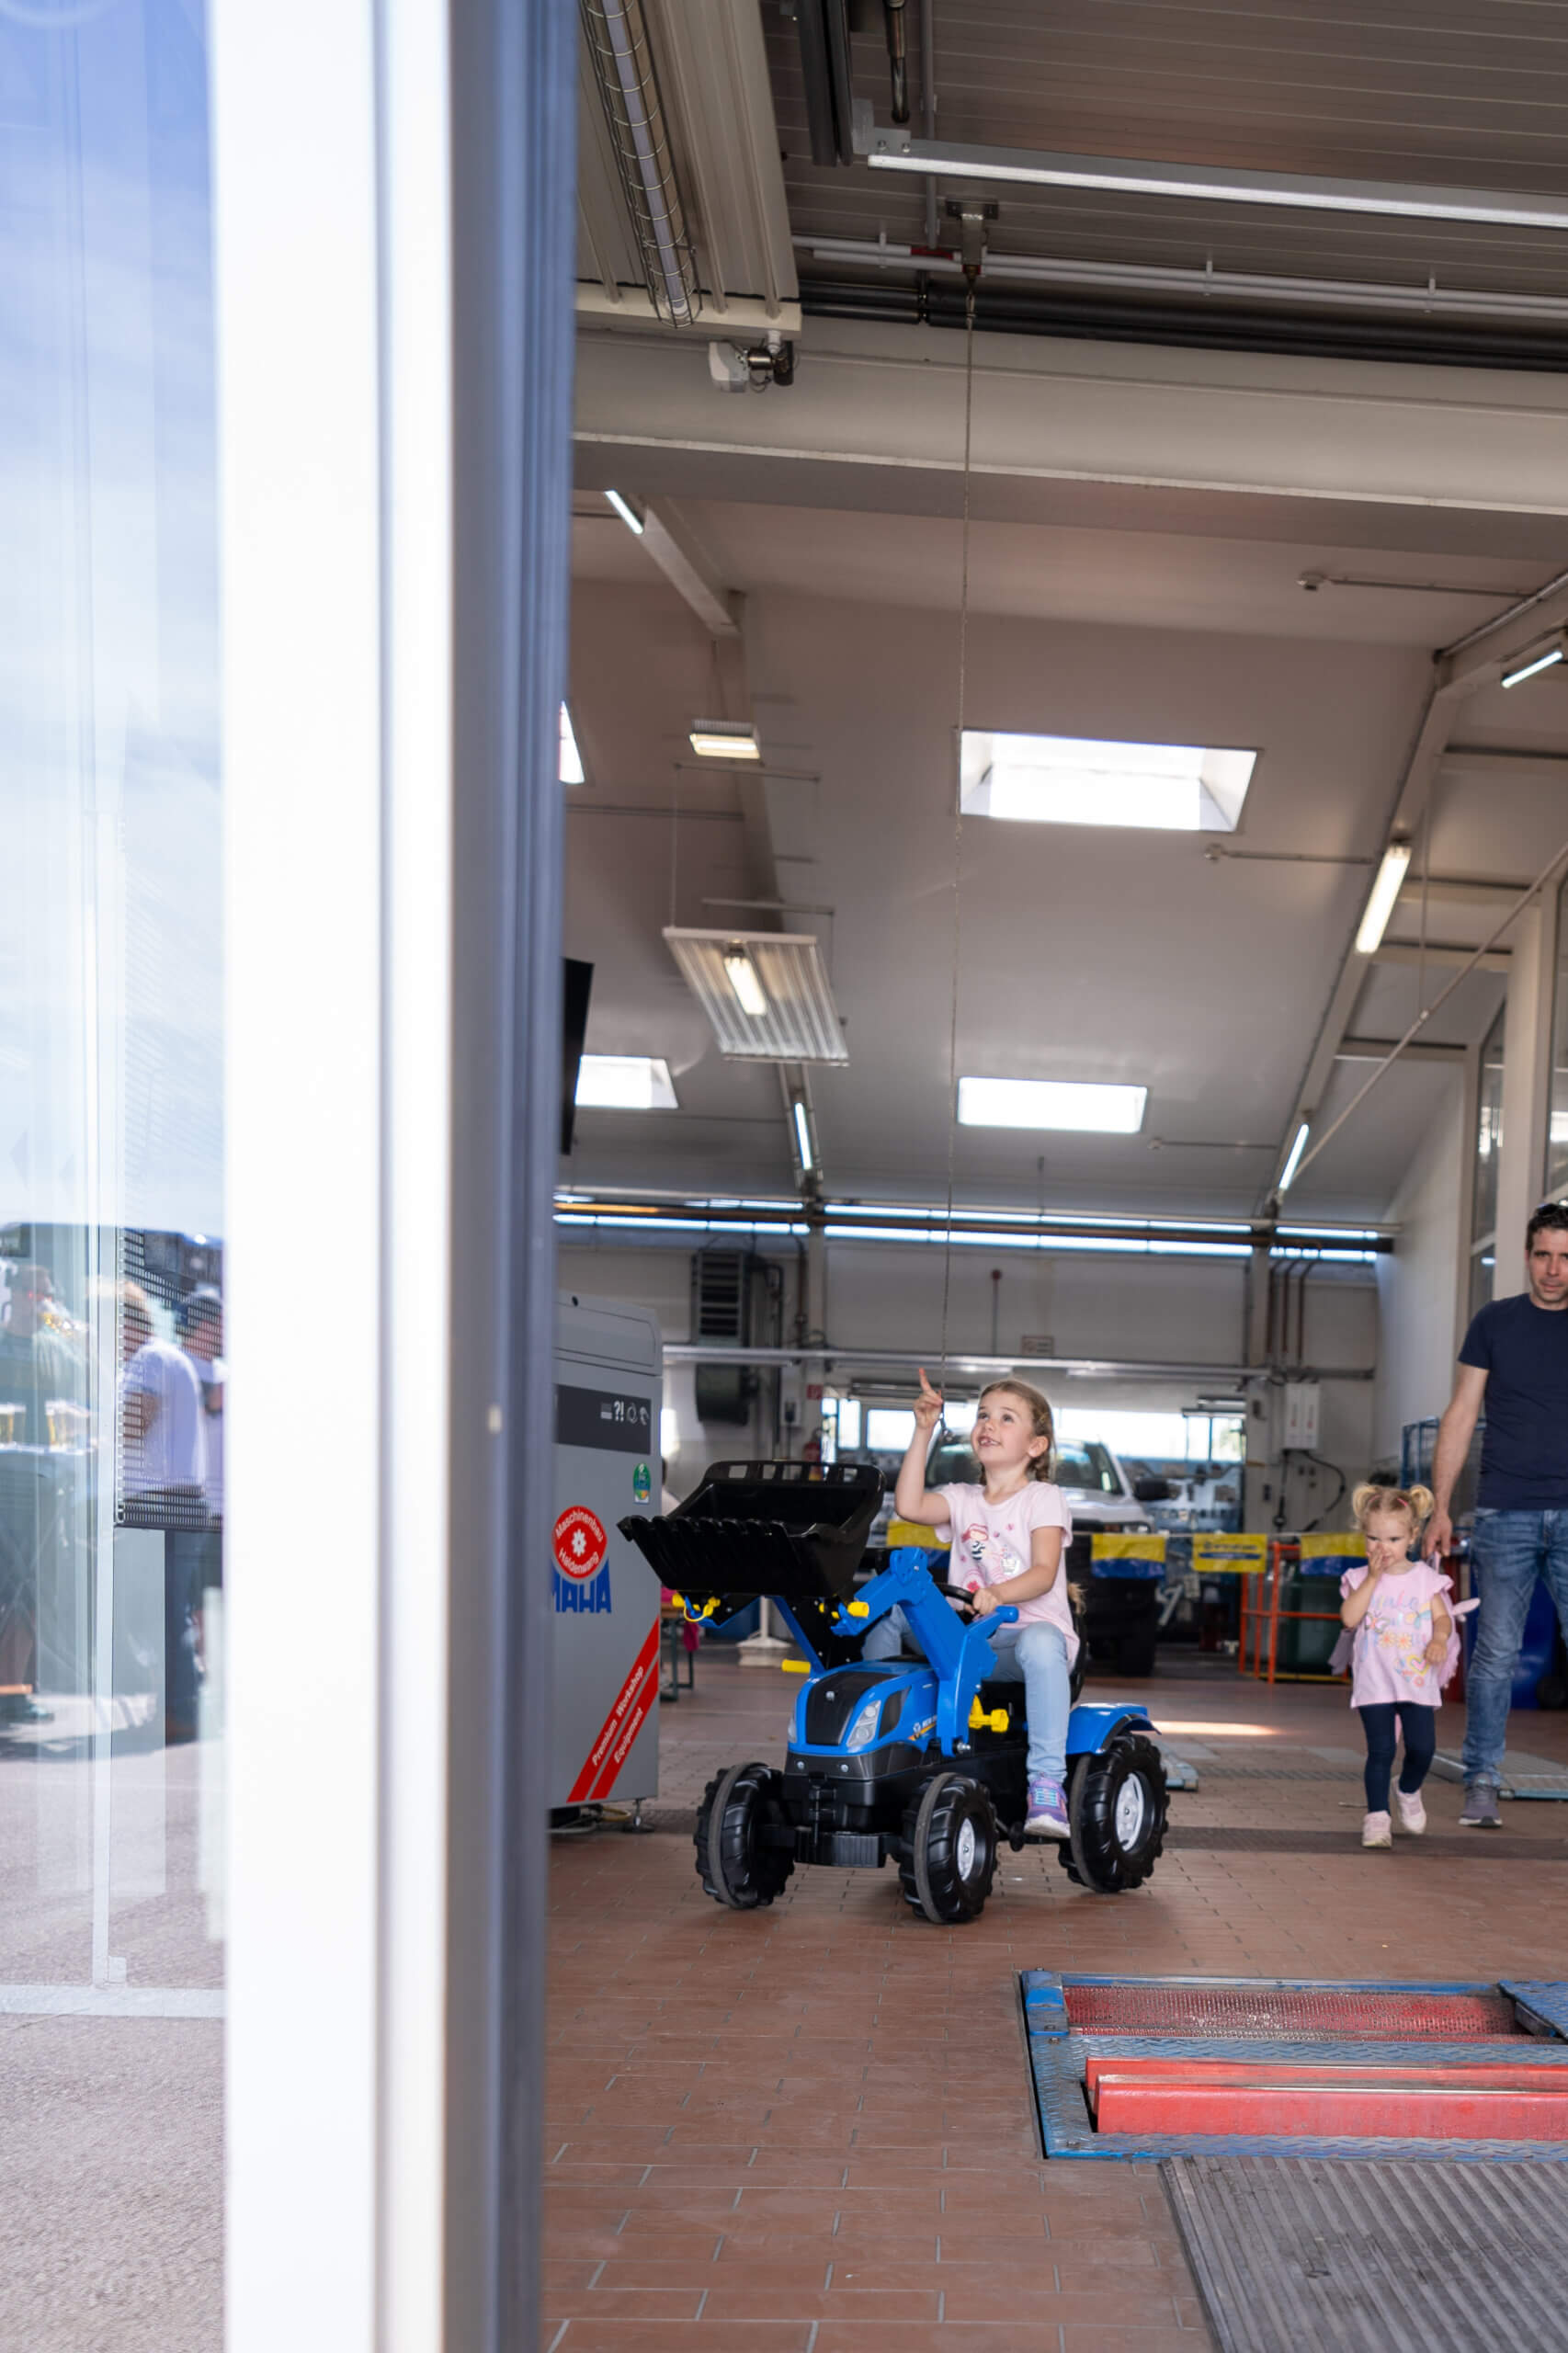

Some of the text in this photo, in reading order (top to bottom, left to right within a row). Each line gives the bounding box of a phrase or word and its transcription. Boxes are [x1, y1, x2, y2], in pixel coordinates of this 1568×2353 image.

[555, 1508, 603, 1542] Maschinenbau
[559, 1548, 599, 1574] Haldenwang
[592, 1665, 644, 1767] Premium Workshop
[614, 1707, 643, 1764] Equipment
